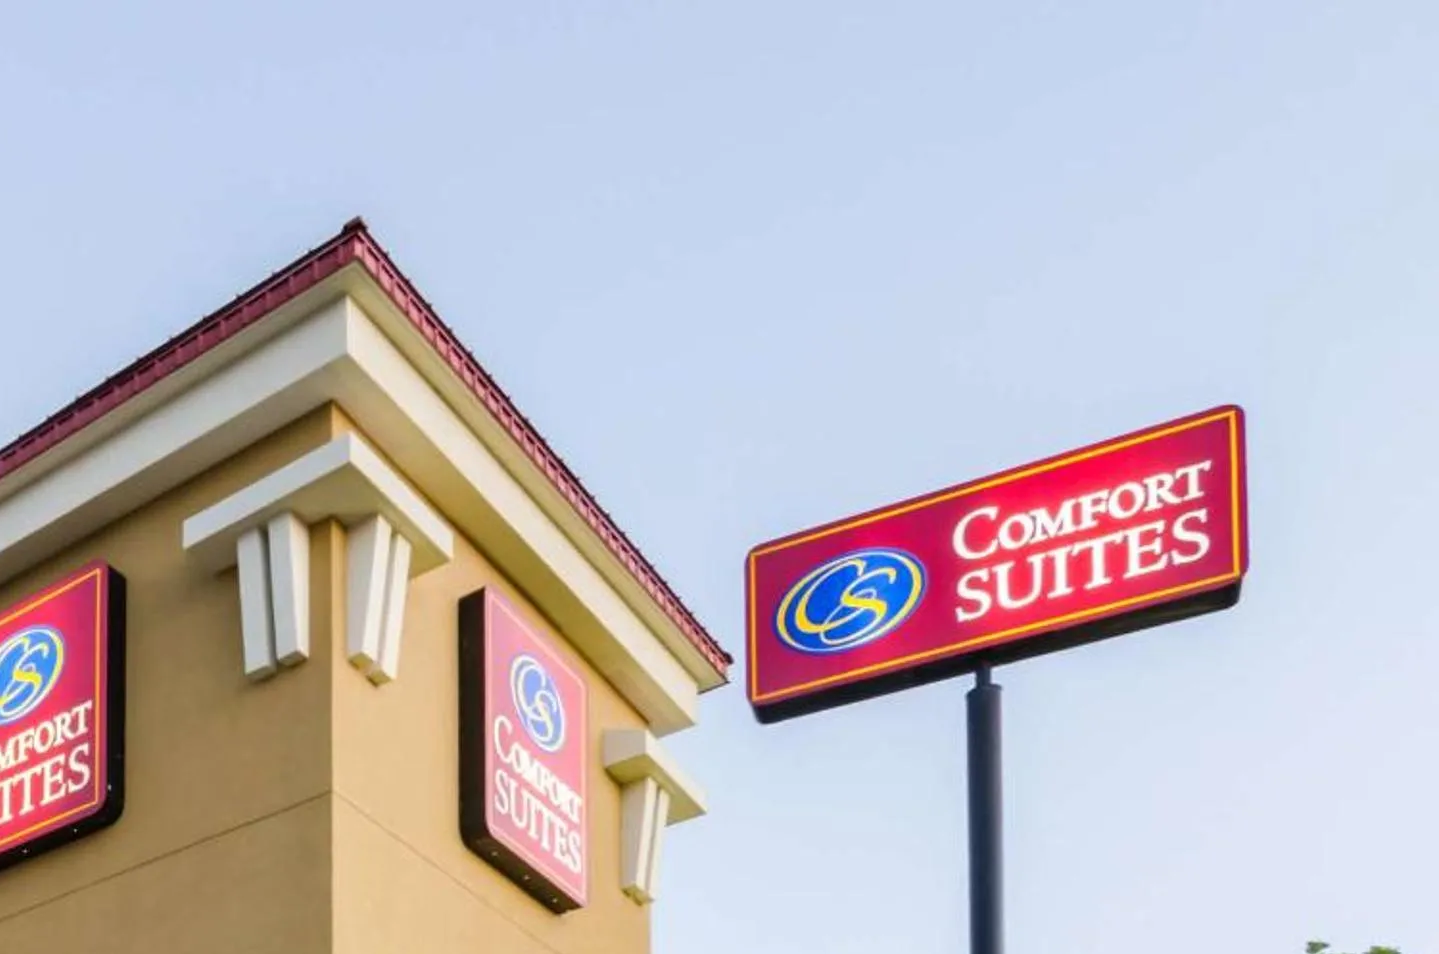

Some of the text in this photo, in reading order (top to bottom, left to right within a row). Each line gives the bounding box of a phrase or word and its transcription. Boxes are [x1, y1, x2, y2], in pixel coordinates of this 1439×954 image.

[952, 461, 1212, 560] COMFORT
[955, 509, 1210, 622] SUITES
[494, 715, 583, 823] COMFORT
[494, 769, 582, 874] SUITES
